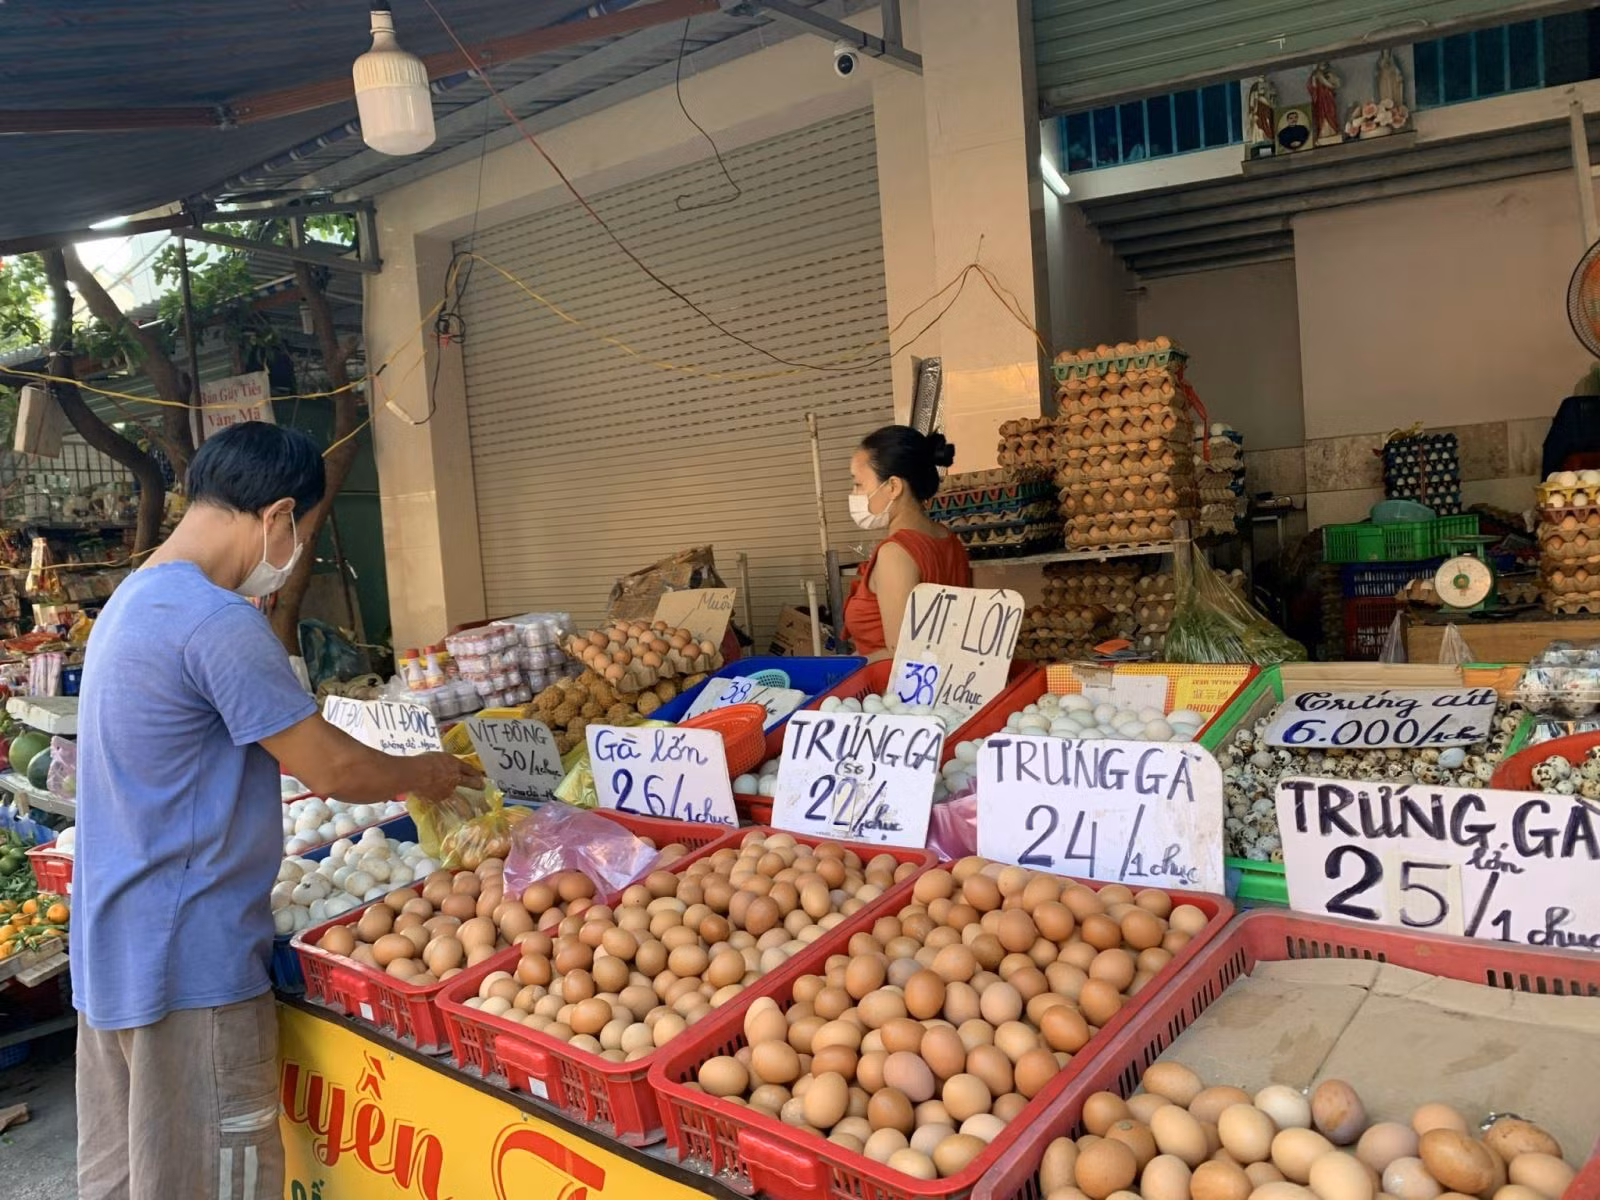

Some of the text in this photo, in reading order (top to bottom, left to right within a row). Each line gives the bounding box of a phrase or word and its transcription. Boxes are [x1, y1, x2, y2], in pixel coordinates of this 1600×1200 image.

[469, 719, 498, 748] VỊT
[595, 728, 709, 766] Gà lớn
[987, 738, 1202, 802] TRỨNG GÀ
[1281, 780, 1497, 850] TRỨNG
